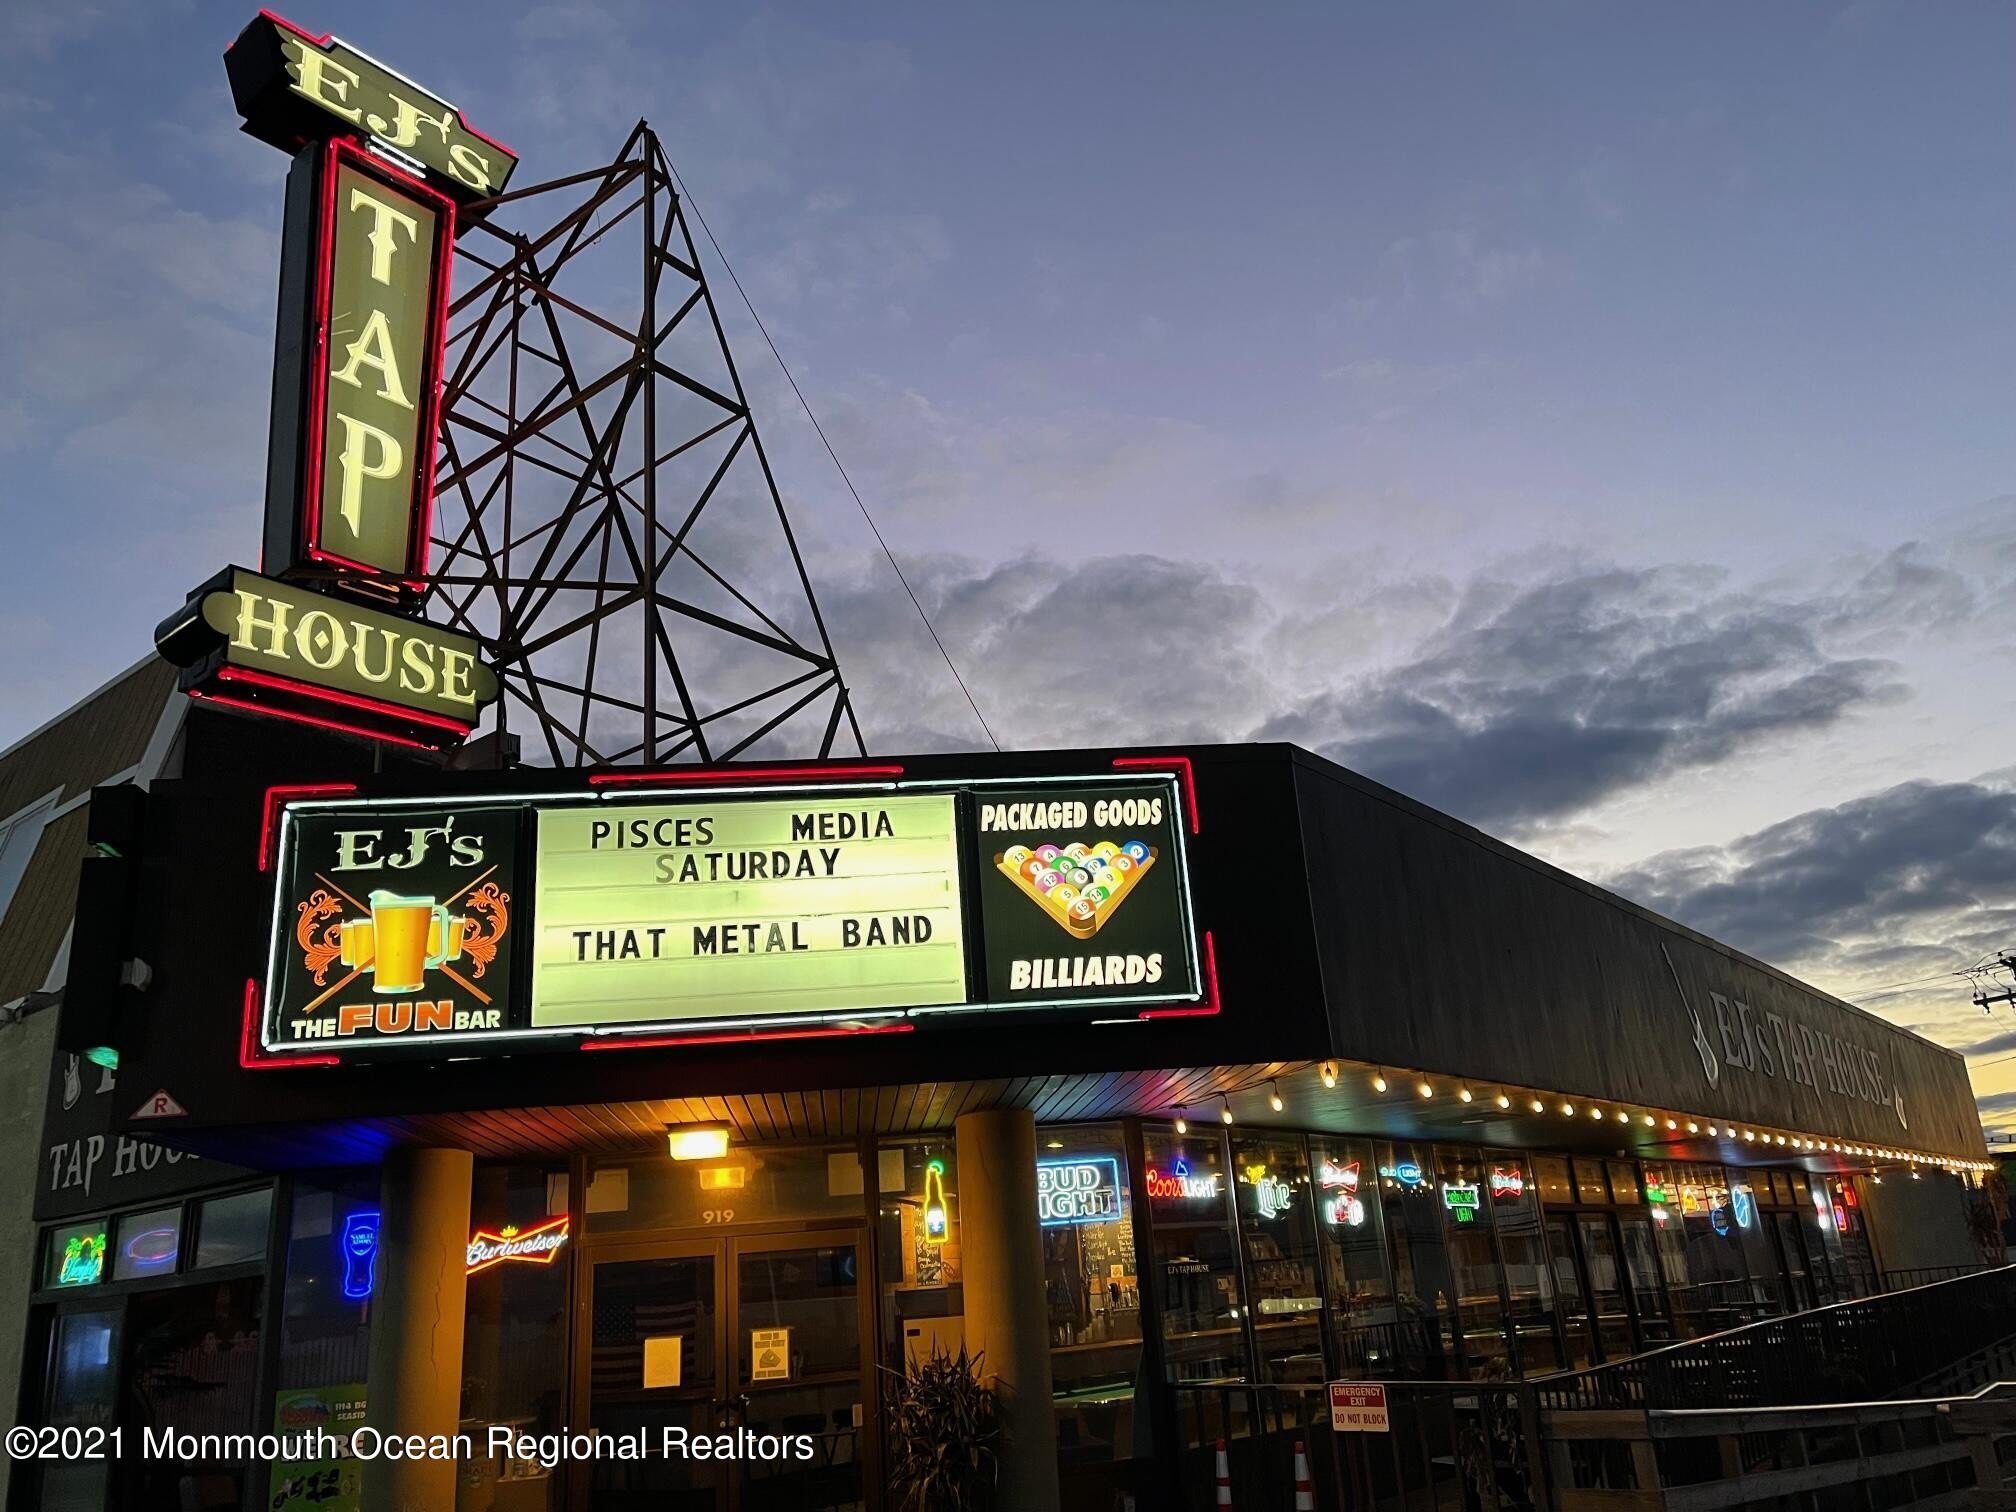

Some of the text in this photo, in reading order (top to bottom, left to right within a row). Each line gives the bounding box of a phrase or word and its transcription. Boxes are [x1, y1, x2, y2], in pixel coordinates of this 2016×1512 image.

[331, 188, 417, 538] TAP
[230, 589, 478, 704] HOUSE
[591, 810, 895, 849] PISCES MEDIA
[980, 798, 1162, 832] PACKAGED GOODS
[655, 848, 841, 884] SATURDAY
[572, 915, 932, 961] THAT METAL BAND
[1010, 953, 1163, 990] BILLIARDS
[291, 1000, 501, 1039] THE FUN BAR
[1766, 1011, 1823, 1106] TAP
[1815, 1030, 1892, 1107] HOUSE
[154, 1097, 168, 1114] R
[50, 1135, 105, 1197] TAP
[1037, 1165, 1100, 1192] BUD
[1146, 1169, 1216, 1198] Coors LIGHT
[1039, 1190, 1113, 1219] IGHT
[1256, 1178, 1291, 1219] Lite
[702, 1209, 735, 1225] 919
[466, 1234, 569, 1266] Budweiser
[1334, 1387, 1381, 1397] EMERGENCY
[1350, 1397, 1366, 1406] EXIT
[1335, 1413, 1387, 1425] DO NOT BLOCK
